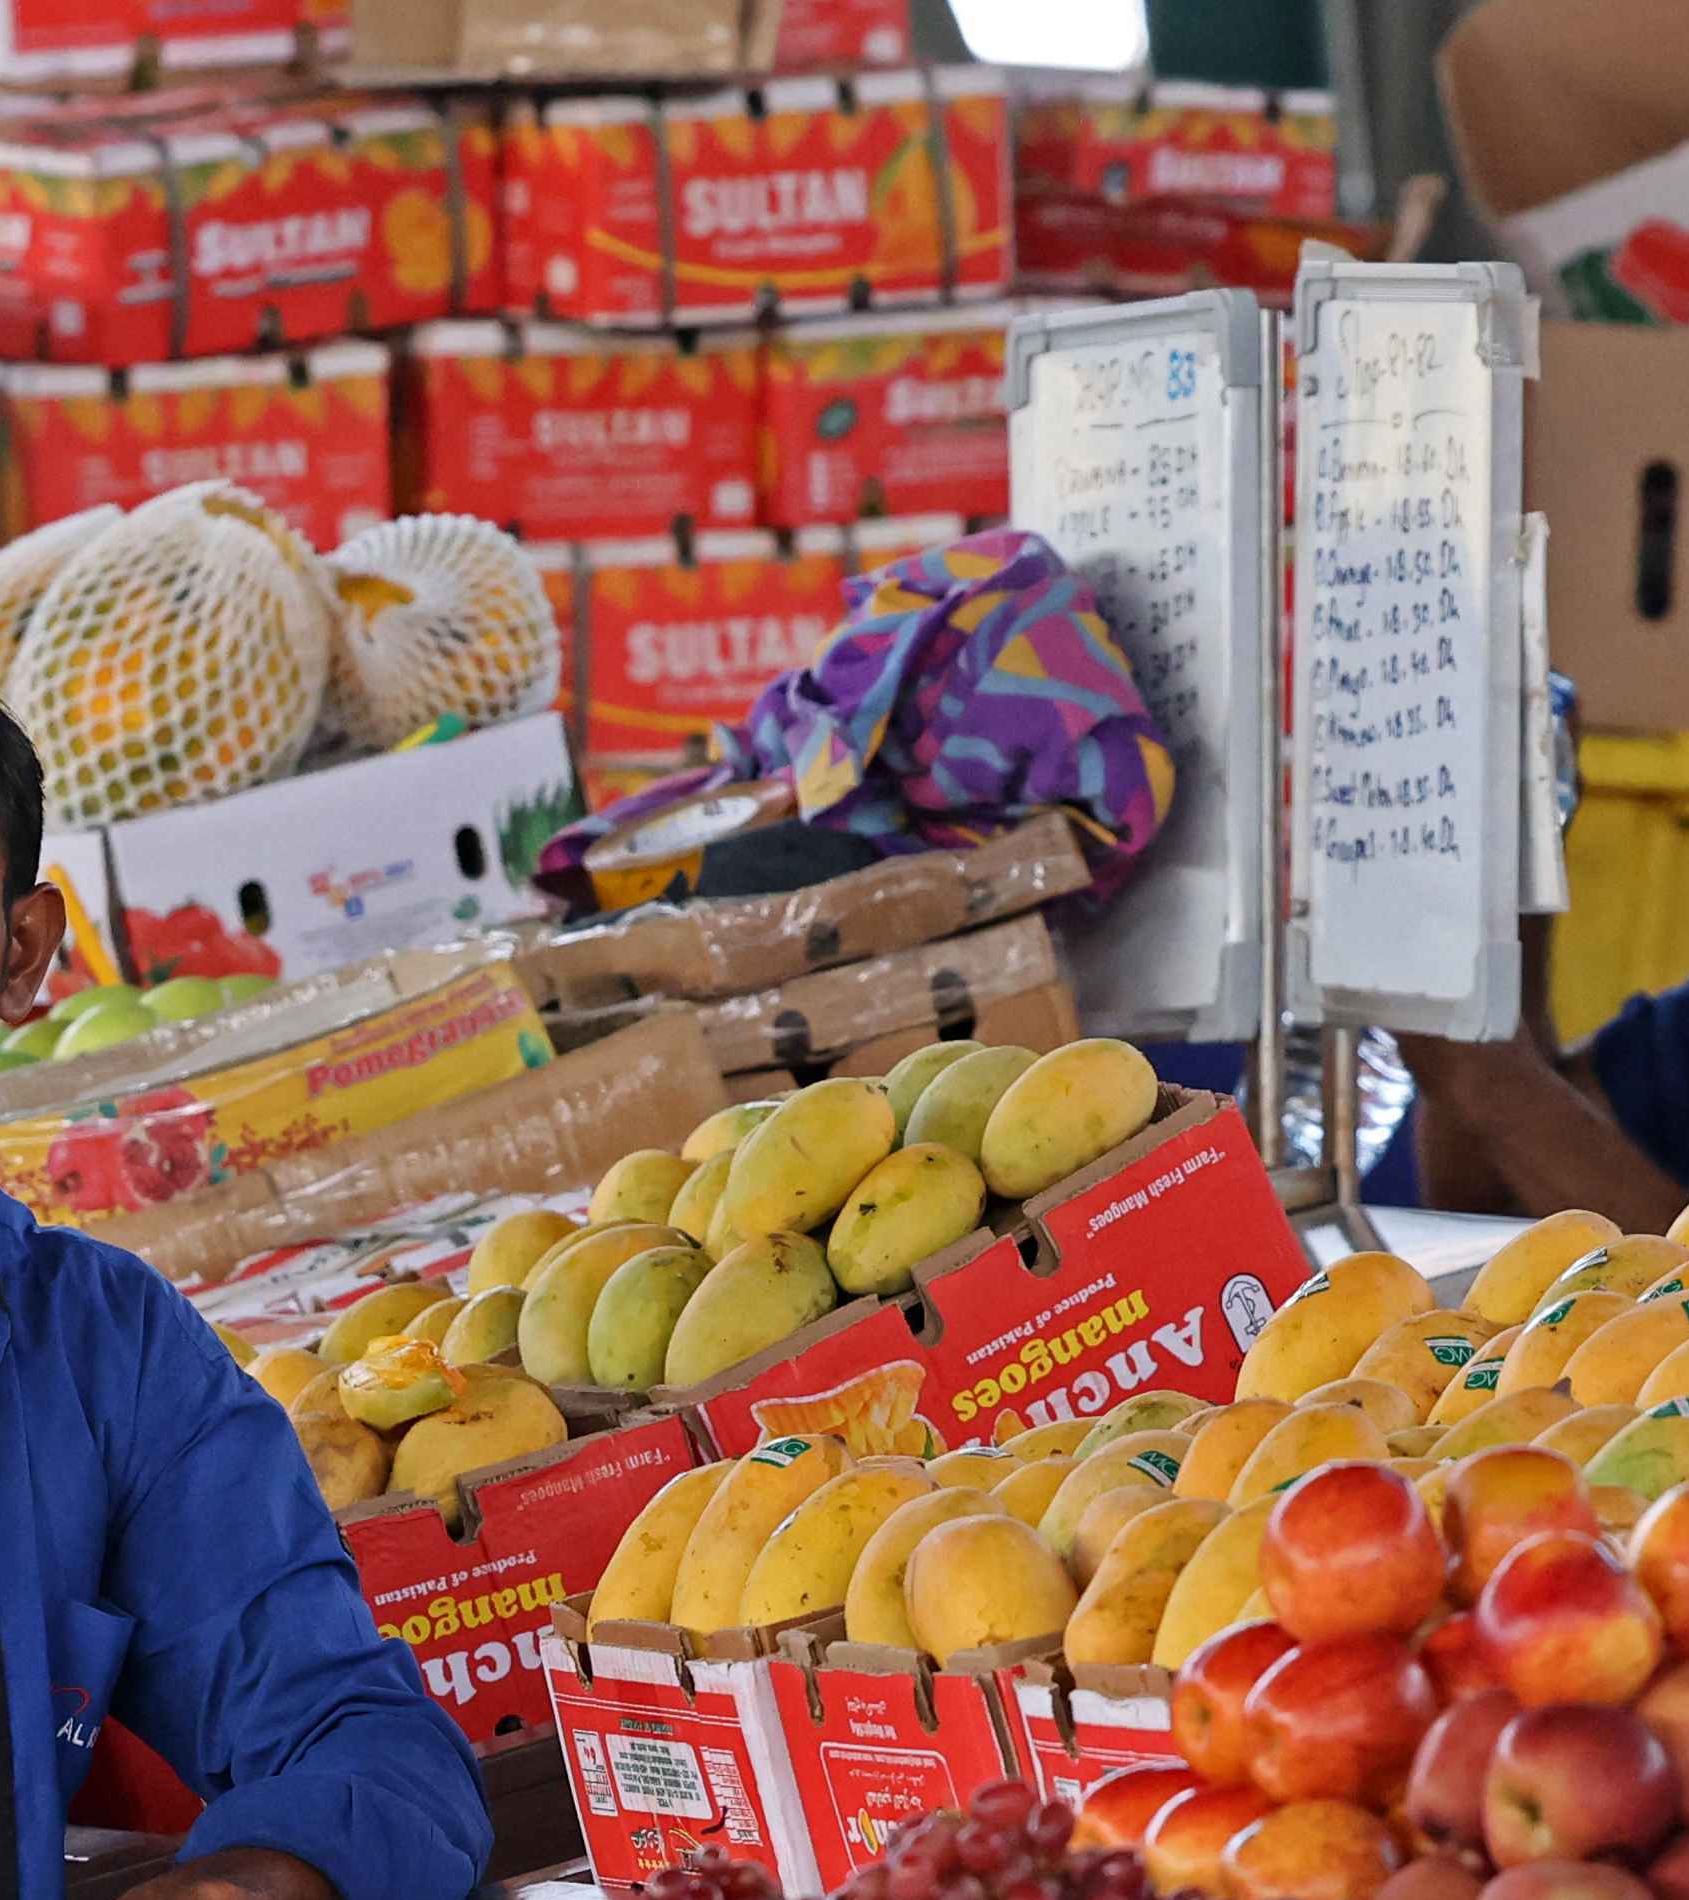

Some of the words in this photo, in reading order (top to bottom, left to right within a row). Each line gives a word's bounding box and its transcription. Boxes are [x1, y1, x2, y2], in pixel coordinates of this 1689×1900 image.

[682, 168, 868, 237] SULTAN
[194, 207, 371, 276] SULTAN
[1149, 1167, 1186, 1195] Fresh
[1054, 1272, 1118, 1316] Produce
[965, 1317, 1035, 1367] Pakistan
[1036, 1309, 1053, 1330] of
[950, 1288, 1151, 1423] mangoes
[1023, 1305, 1205, 1430] Anch
[451, 1571, 469, 1589] of
[472, 1549, 538, 1578] Produce
[374, 1576, 448, 1606] Pakistan
[378, 1572, 567, 1645] mangoe
[422, 1623, 555, 1706] nch
